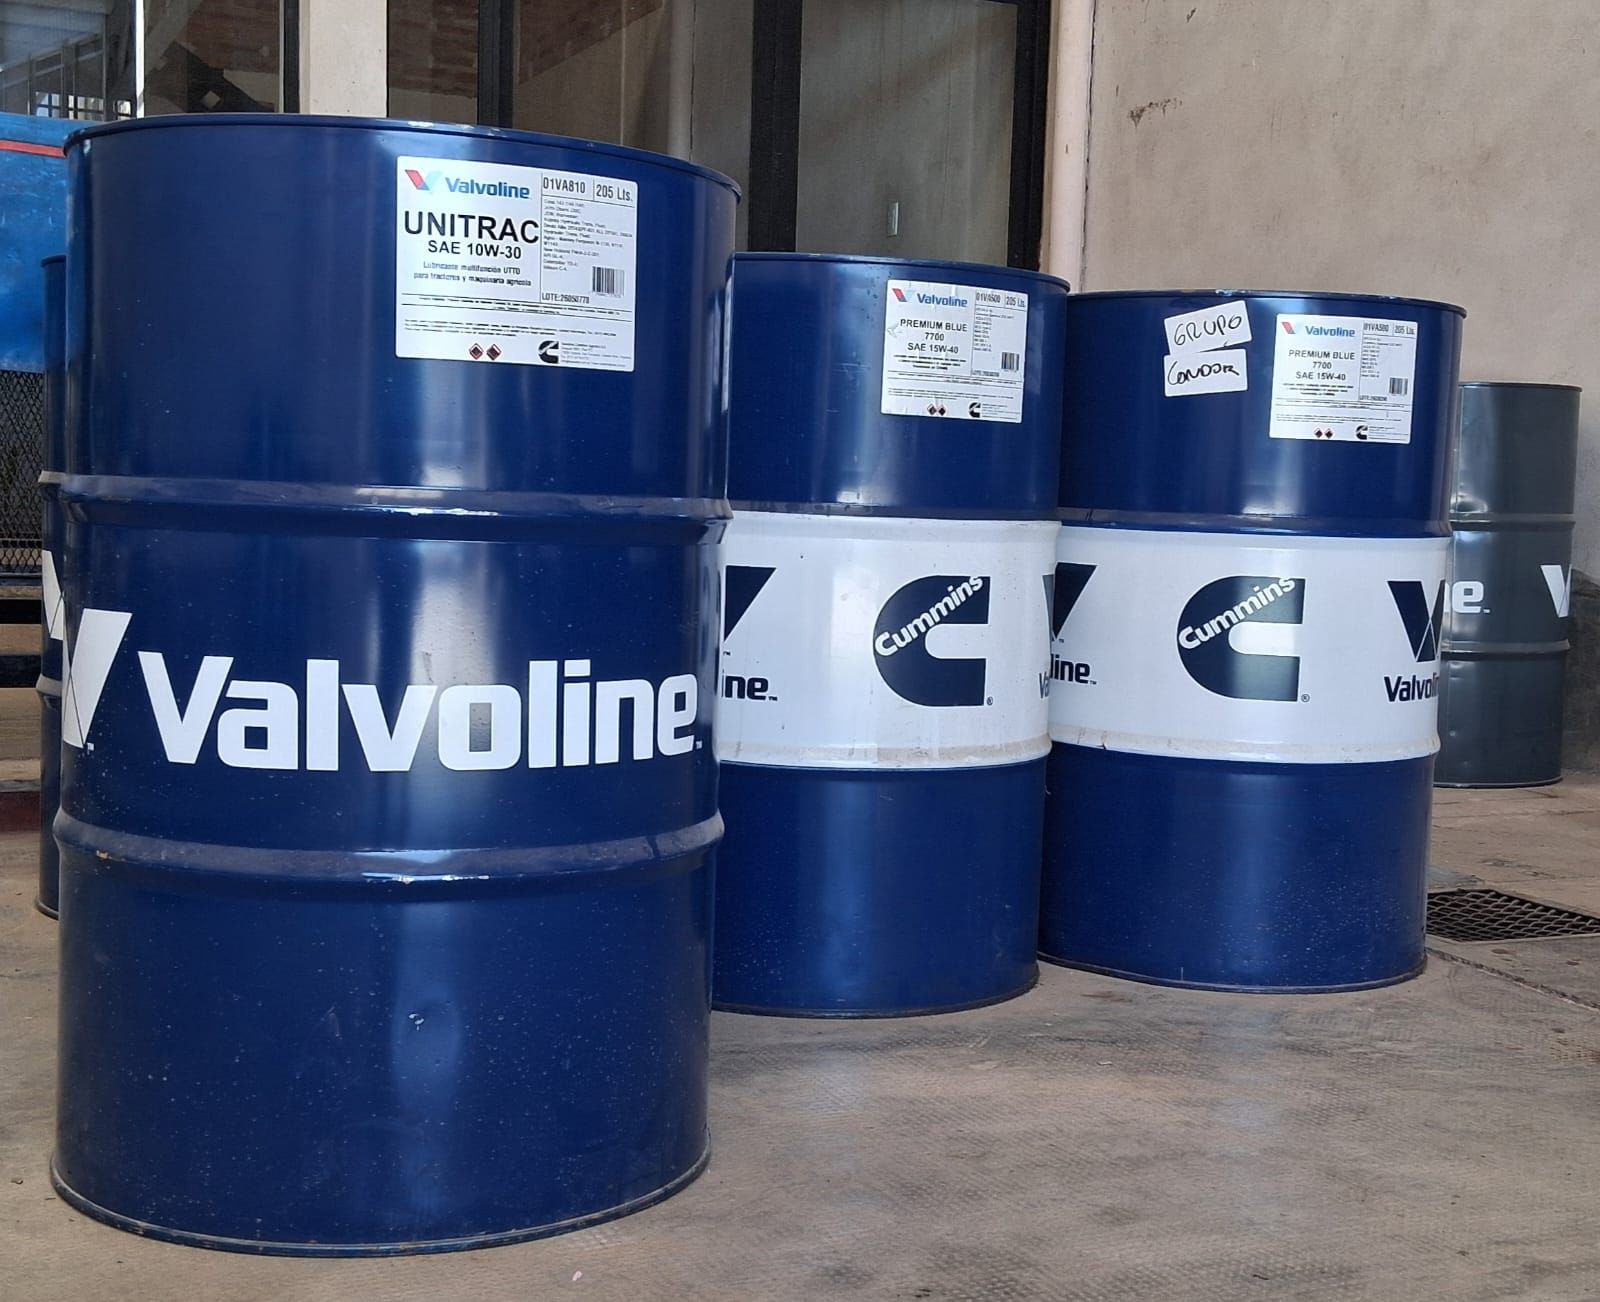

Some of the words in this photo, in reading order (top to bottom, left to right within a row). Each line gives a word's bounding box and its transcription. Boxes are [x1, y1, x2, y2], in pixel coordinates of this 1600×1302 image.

[445, 177, 530, 199] Valvoline
[543, 176, 586, 194] 01VA810
[596, 183, 614, 199] 205
[404, 210, 539, 243] UNITRAC
[428, 240, 461, 255] SAE
[467, 243, 521, 259] 10W-30
[413, 272, 428, 280] para
[462, 275, 467, 283] y
[917, 292, 968, 308] Valvoline
[900, 318, 942, 330] PREMIUM
[945, 322, 968, 332] BLUE
[1173, 314, 1242, 346] GRUPO
[1305, 325, 1356, 338] Valvoline
[924, 332, 945, 342] 7700
[907, 342, 926, 352] SAE
[929, 343, 959, 354] 15W-40
[1288, 350, 1331, 360] PREMIUM
[1332, 351, 1356, 361] BLUE
[1312, 361, 1332, 370] 7700
[1295, 371, 1314, 380] SAE
[1316, 372, 1346, 381] 15W-40
[874, 575, 984, 657] Cummins
[1178, 577, 1296, 650] Cummins
[137, 650, 699, 772] Valvoline
